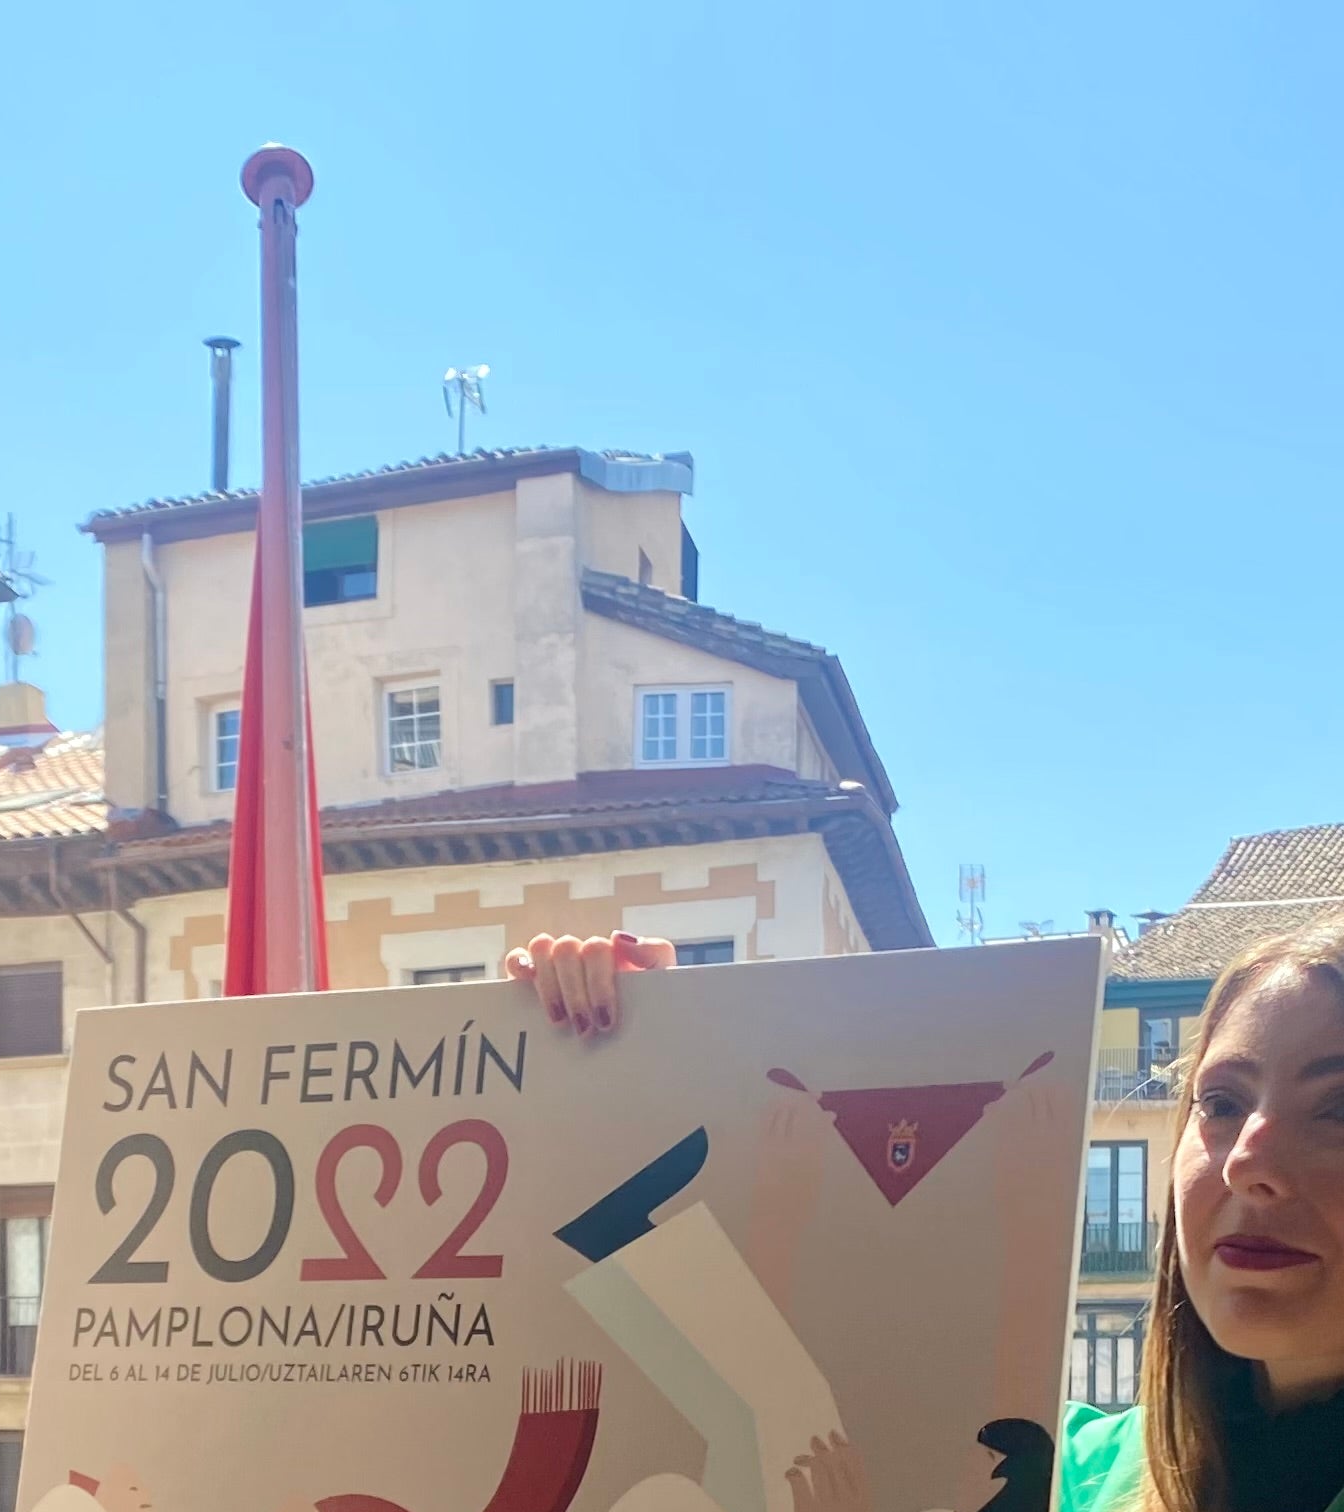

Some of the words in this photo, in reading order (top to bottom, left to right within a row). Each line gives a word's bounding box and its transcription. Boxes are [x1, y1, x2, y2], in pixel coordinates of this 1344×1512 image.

[102, 1048, 233, 1113] SAN
[260, 1020, 527, 1105] FERMÍN
[86, 1118, 510, 1284] 2022
[72, 1292, 495, 1348] PAMPLONA/IRUÑA
[68, 1363, 103, 1382] DEL
[108, 1364, 119, 1382] 6
[124, 1363, 148, 1382] AL
[155, 1363, 170, 1382] 14
[176, 1363, 202, 1382] DE
[206, 1363, 392, 1384] JULIO/UZTAILAREN
[399, 1363, 441, 1382] 6TIK
[448, 1363, 491, 1383] 14RA
